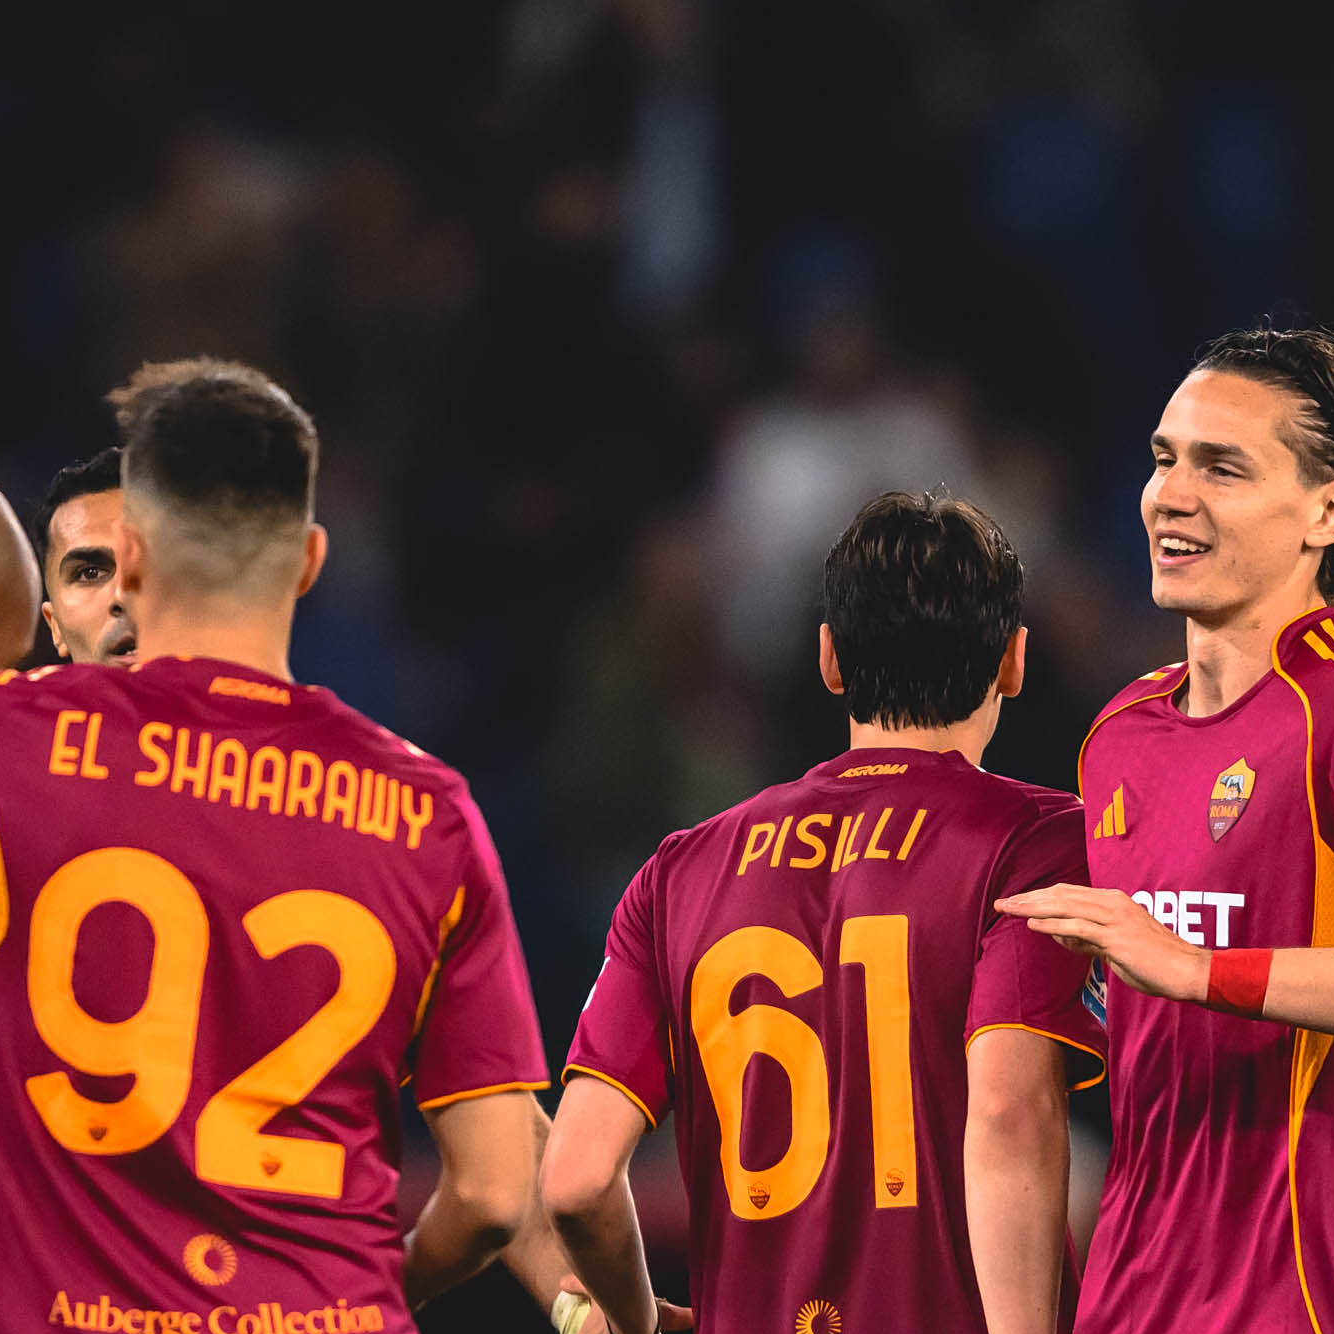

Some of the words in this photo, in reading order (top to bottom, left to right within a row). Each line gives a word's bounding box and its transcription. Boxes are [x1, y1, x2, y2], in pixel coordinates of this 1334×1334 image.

[48, 709, 109, 780] EL
[133, 720, 434, 850] SHAARAWY
[736, 807, 928, 876] PISILLI
[25, 846, 397, 1199] 92
[690, 914, 917, 1221] 61
